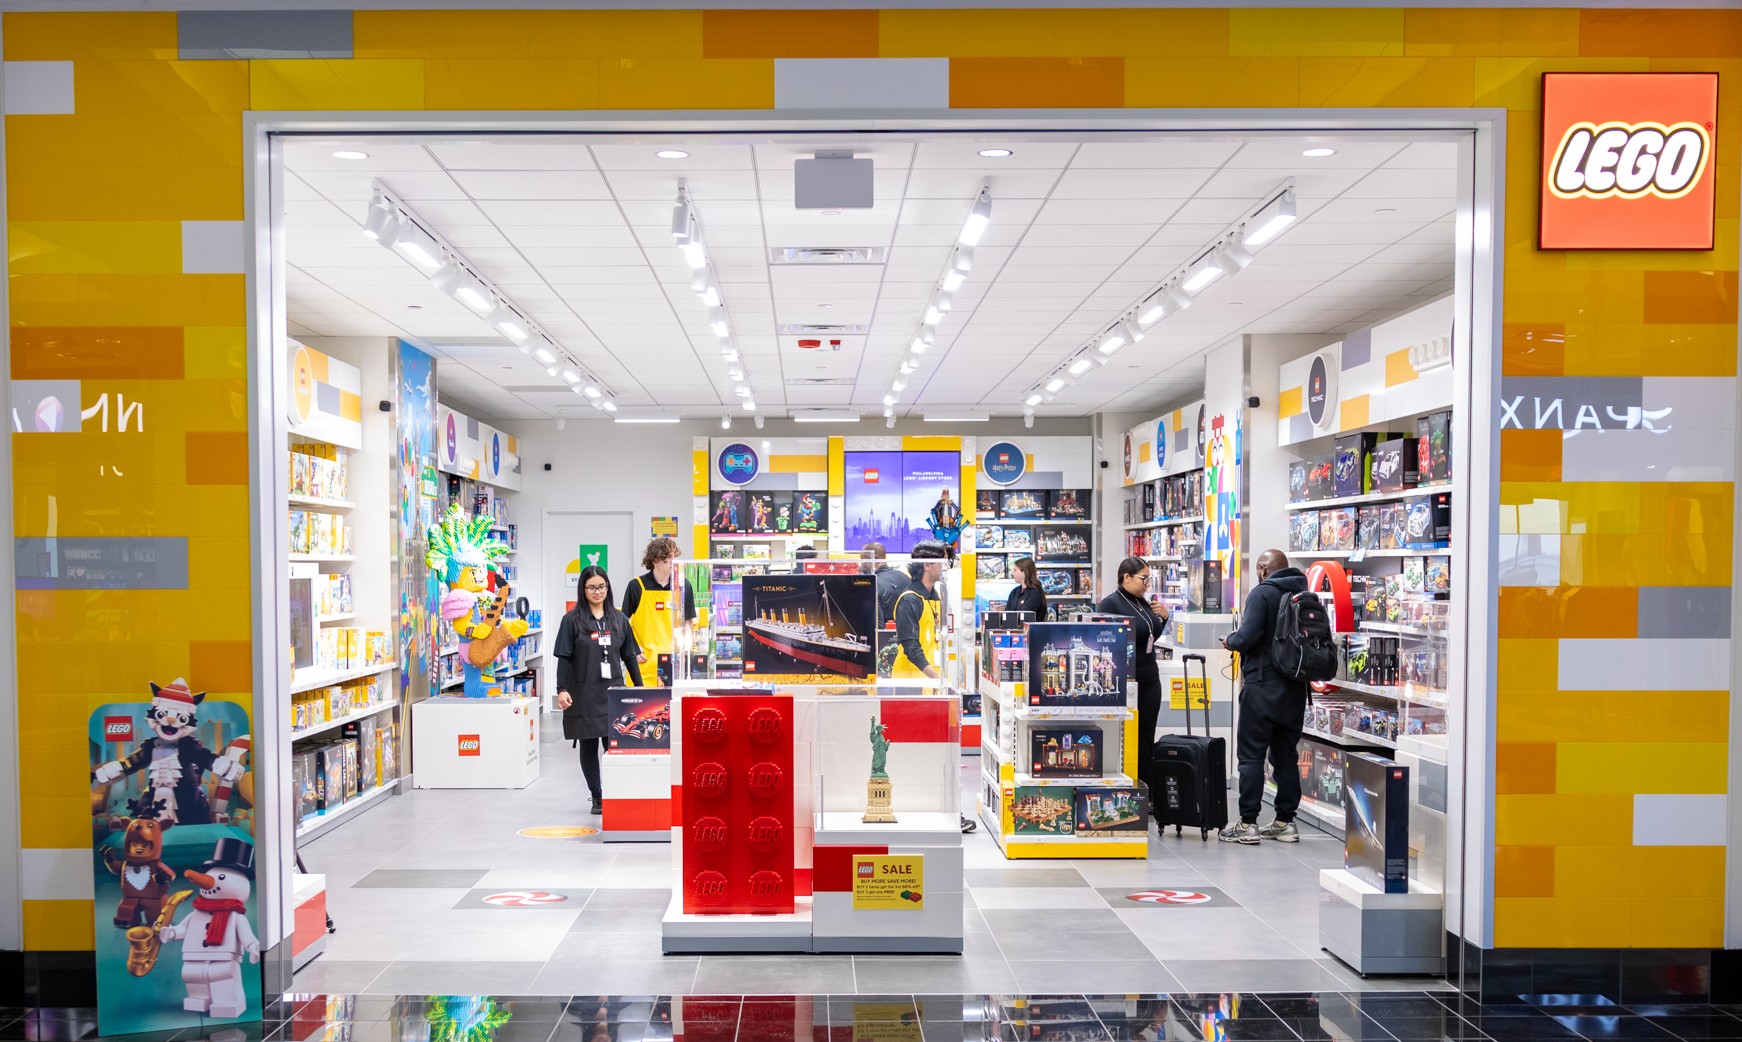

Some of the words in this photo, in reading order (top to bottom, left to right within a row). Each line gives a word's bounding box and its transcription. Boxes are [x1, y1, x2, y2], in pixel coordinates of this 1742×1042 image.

[1553, 127, 1706, 194] LEGO
[864, 472, 879, 480] LEGO
[106, 722, 131, 734] LEGO
[693, 717, 724, 732] LEGO
[749, 717, 780, 732] LEGO
[459, 740, 480, 750] LEGO
[694, 772, 725, 787] LEGO
[749, 772, 780, 787] LEGO
[694, 826, 725, 841] LEGO
[750, 826, 781, 841] LEGO
[858, 866, 873, 874] LEGO
[882, 864, 912, 874] SALE
[695, 880, 726, 895] LEGO
[751, 880, 782, 895] LEGO
